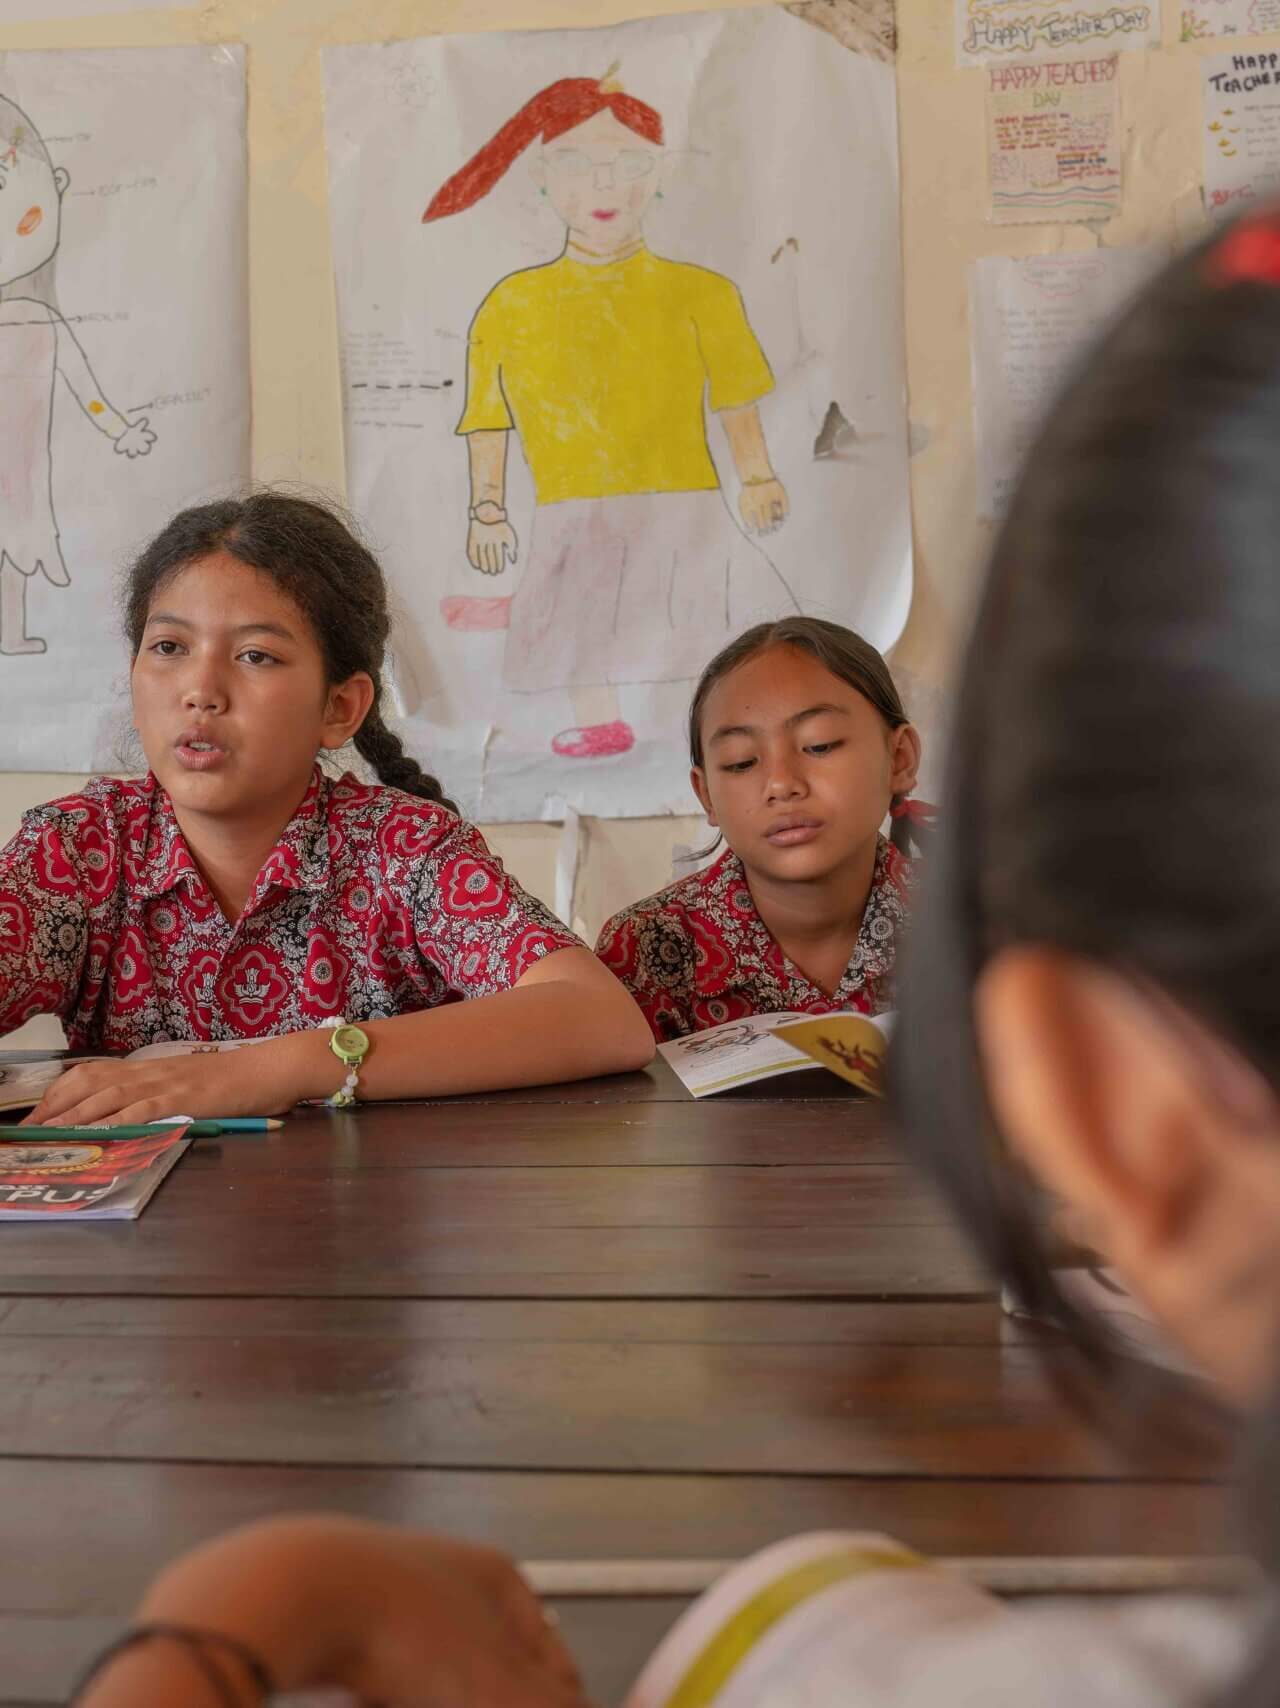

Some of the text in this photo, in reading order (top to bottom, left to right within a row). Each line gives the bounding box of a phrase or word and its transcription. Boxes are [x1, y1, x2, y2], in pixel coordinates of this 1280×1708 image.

[972, 10, 1145, 49] HAPPY TEACHER DAY
[990, 65, 1041, 92] HAPPY
